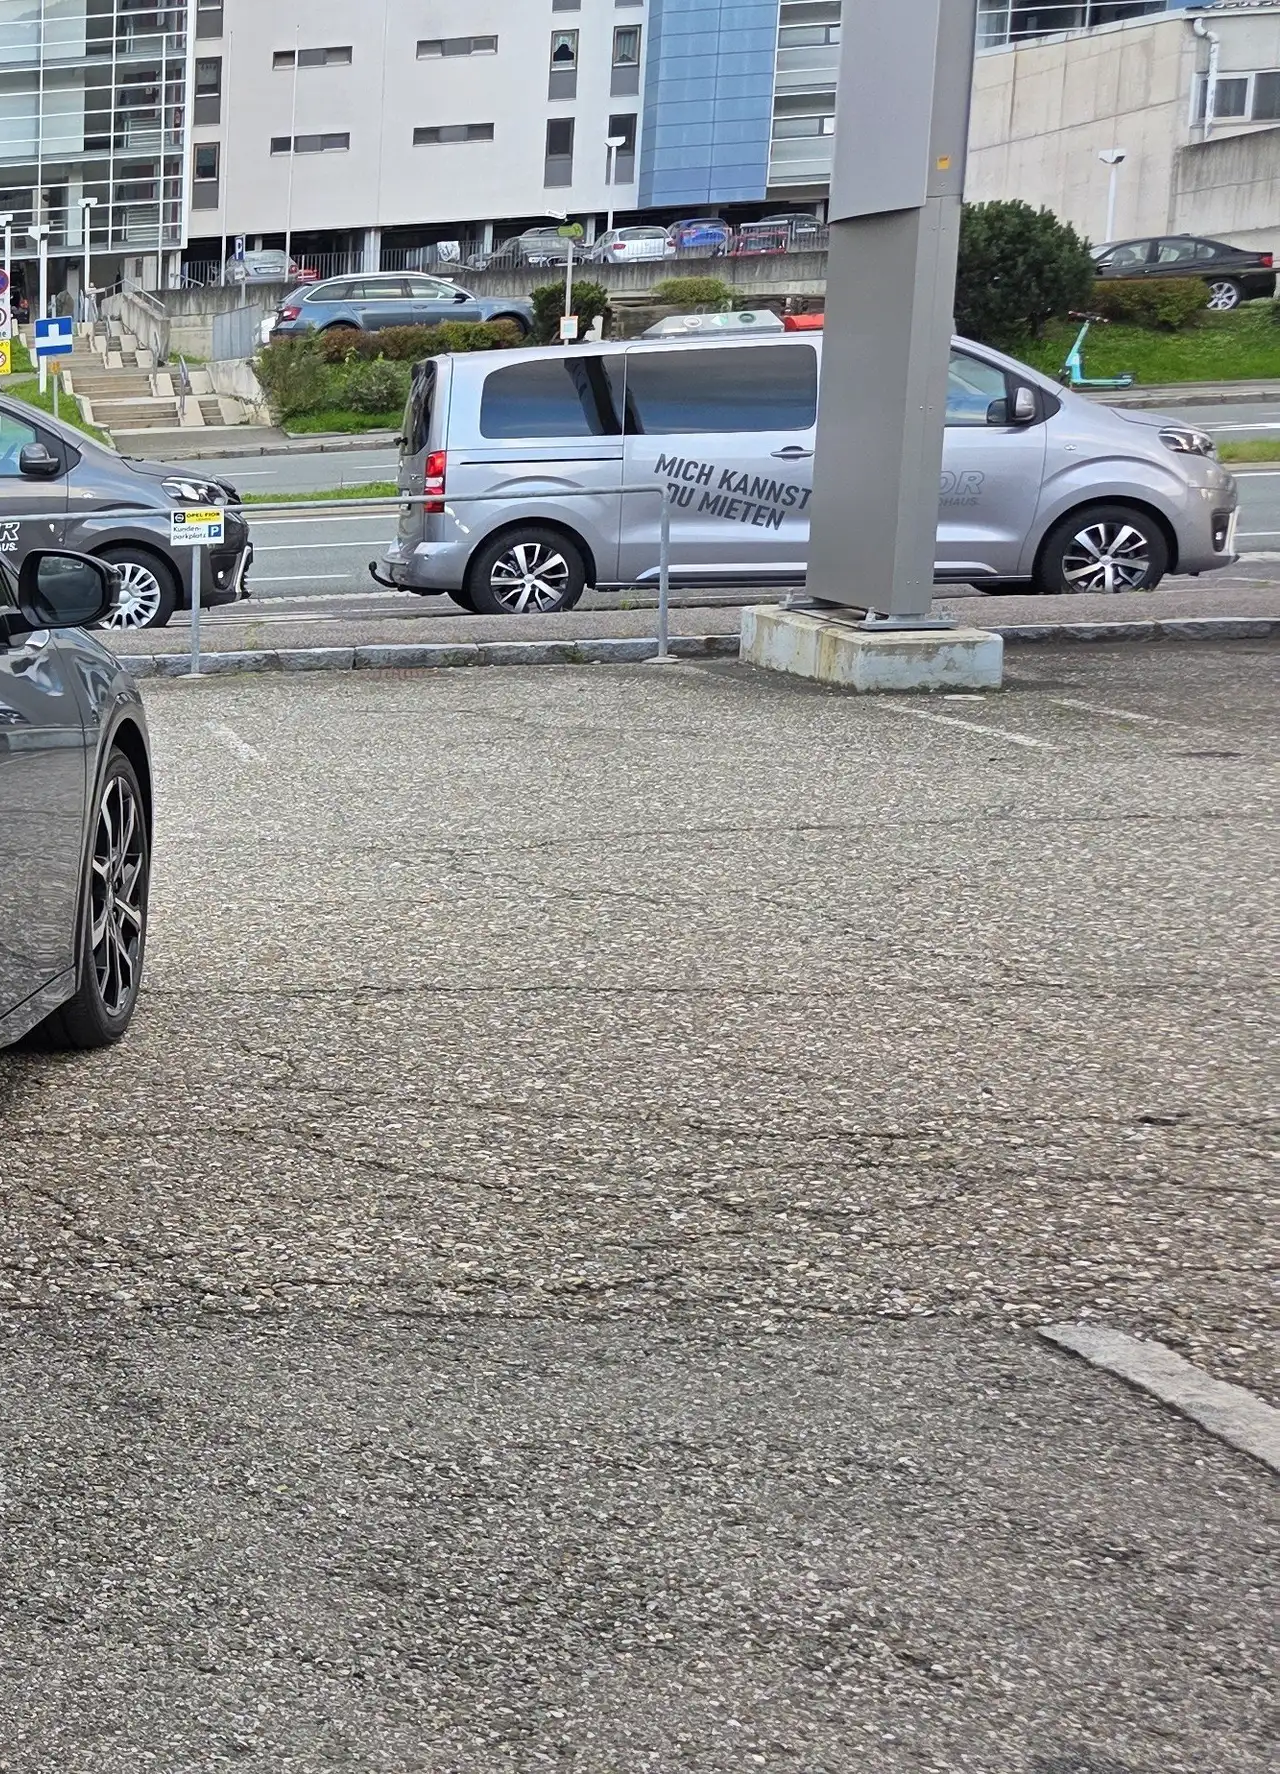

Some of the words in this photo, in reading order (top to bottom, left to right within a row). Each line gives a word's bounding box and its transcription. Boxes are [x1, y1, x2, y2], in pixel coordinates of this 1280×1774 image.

[235, 239, 243, 260] P
[654, 453, 715, 486] MICH
[717, 468, 813, 510] KANNST
[666, 482, 696, 508] DU
[697, 491, 786, 531] MIETEN
[210, 526, 220, 536] P
